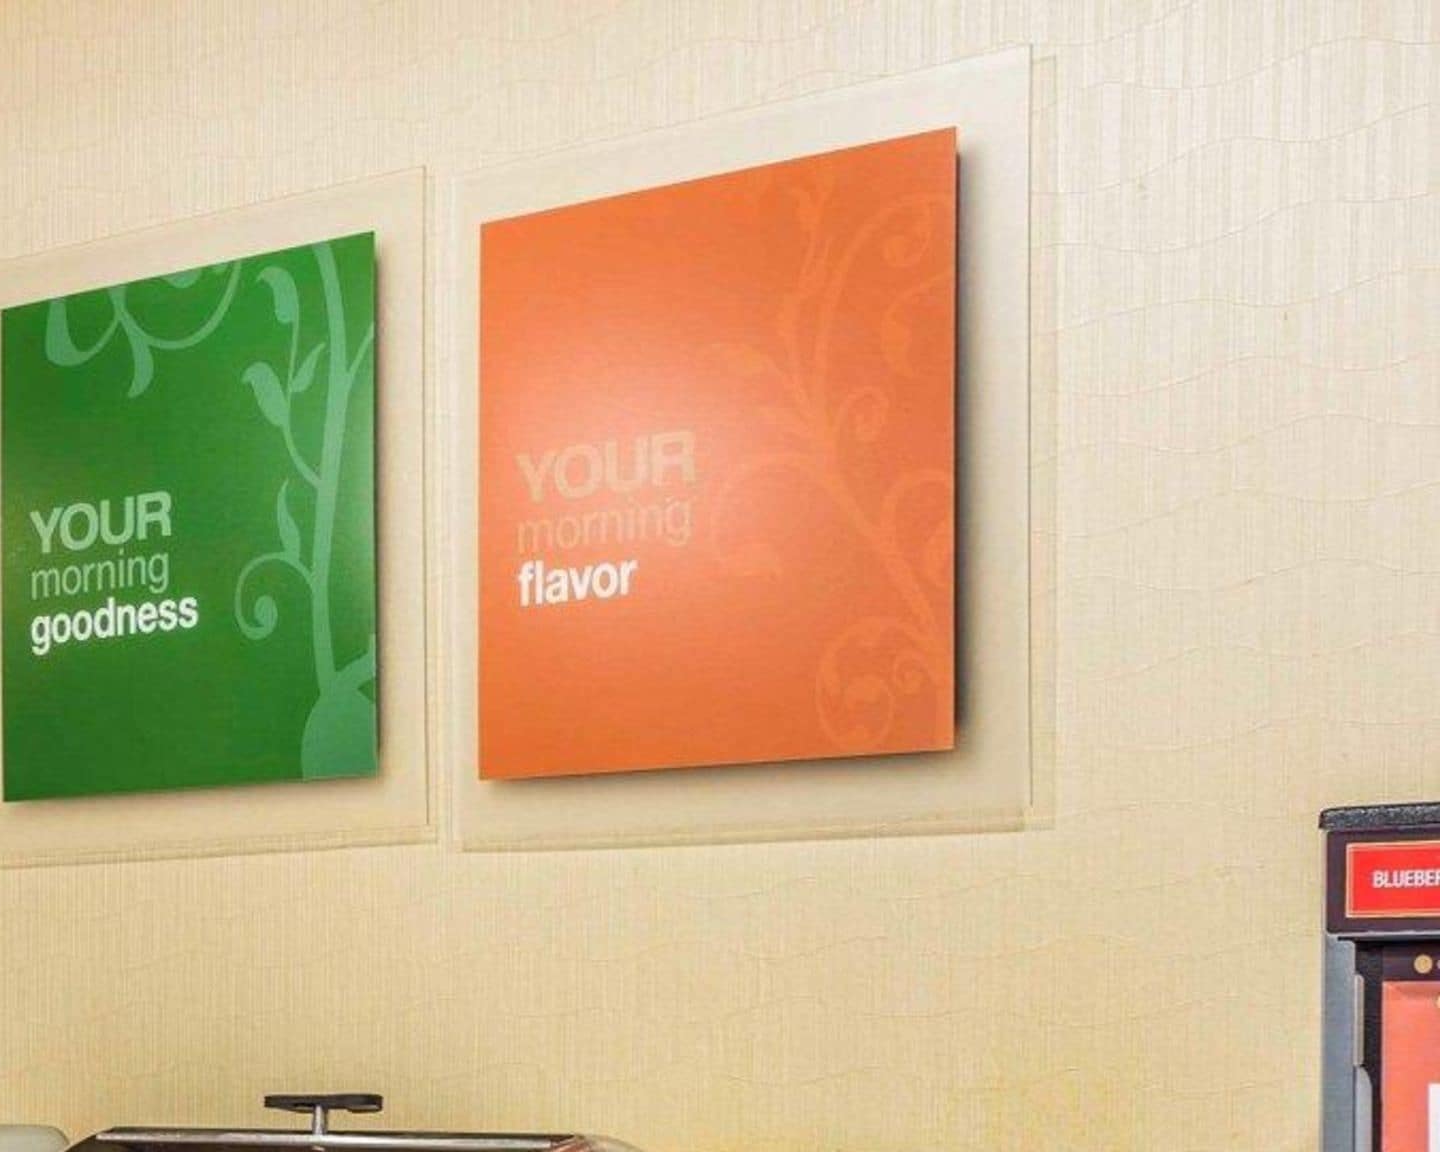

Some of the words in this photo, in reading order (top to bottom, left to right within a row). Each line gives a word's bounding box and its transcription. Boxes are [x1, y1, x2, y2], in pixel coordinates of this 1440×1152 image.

[516, 430, 697, 502] YOUR
[30, 491, 173, 554] YOUR
[517, 496, 692, 554] morning
[31, 551, 170, 600] morning
[518, 559, 638, 608] flavor
[31, 596, 199, 656] goodness
